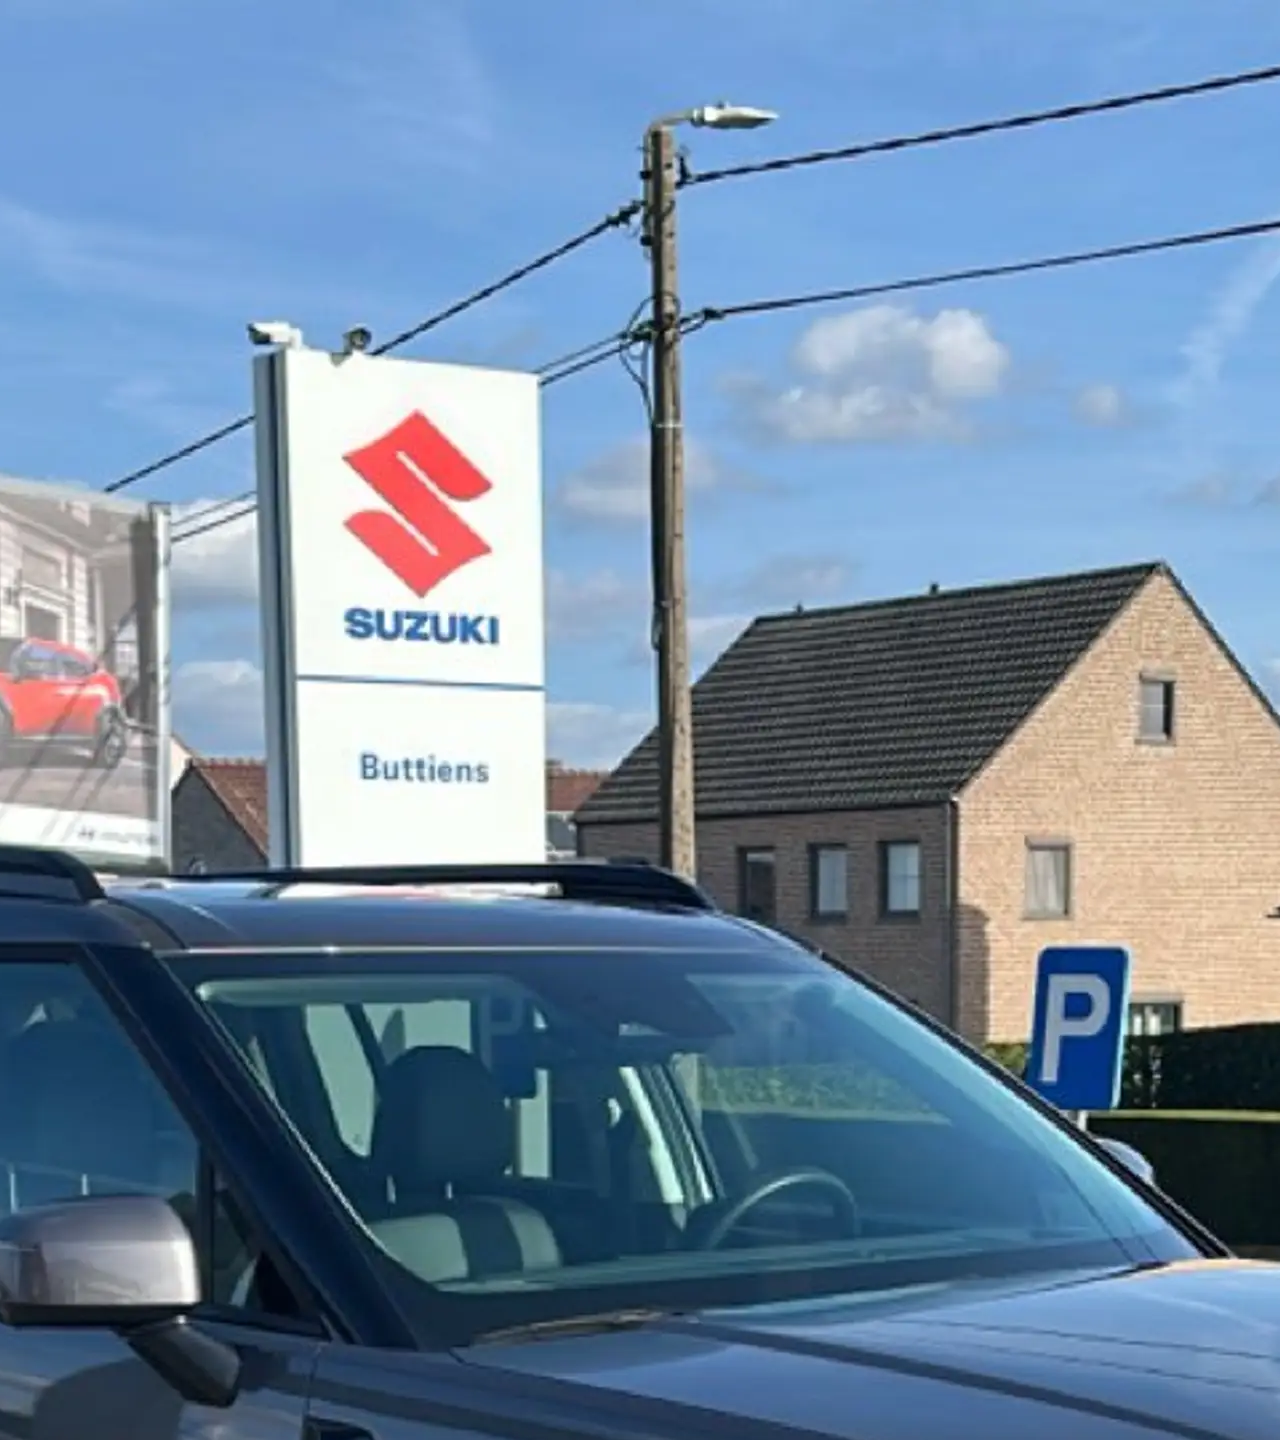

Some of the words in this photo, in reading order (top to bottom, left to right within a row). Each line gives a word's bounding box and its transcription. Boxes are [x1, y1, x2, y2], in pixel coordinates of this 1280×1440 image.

[344, 607, 500, 645] SUZUKI
[360, 752, 490, 784] Buttiens
[1039, 972, 1110, 1083] P
